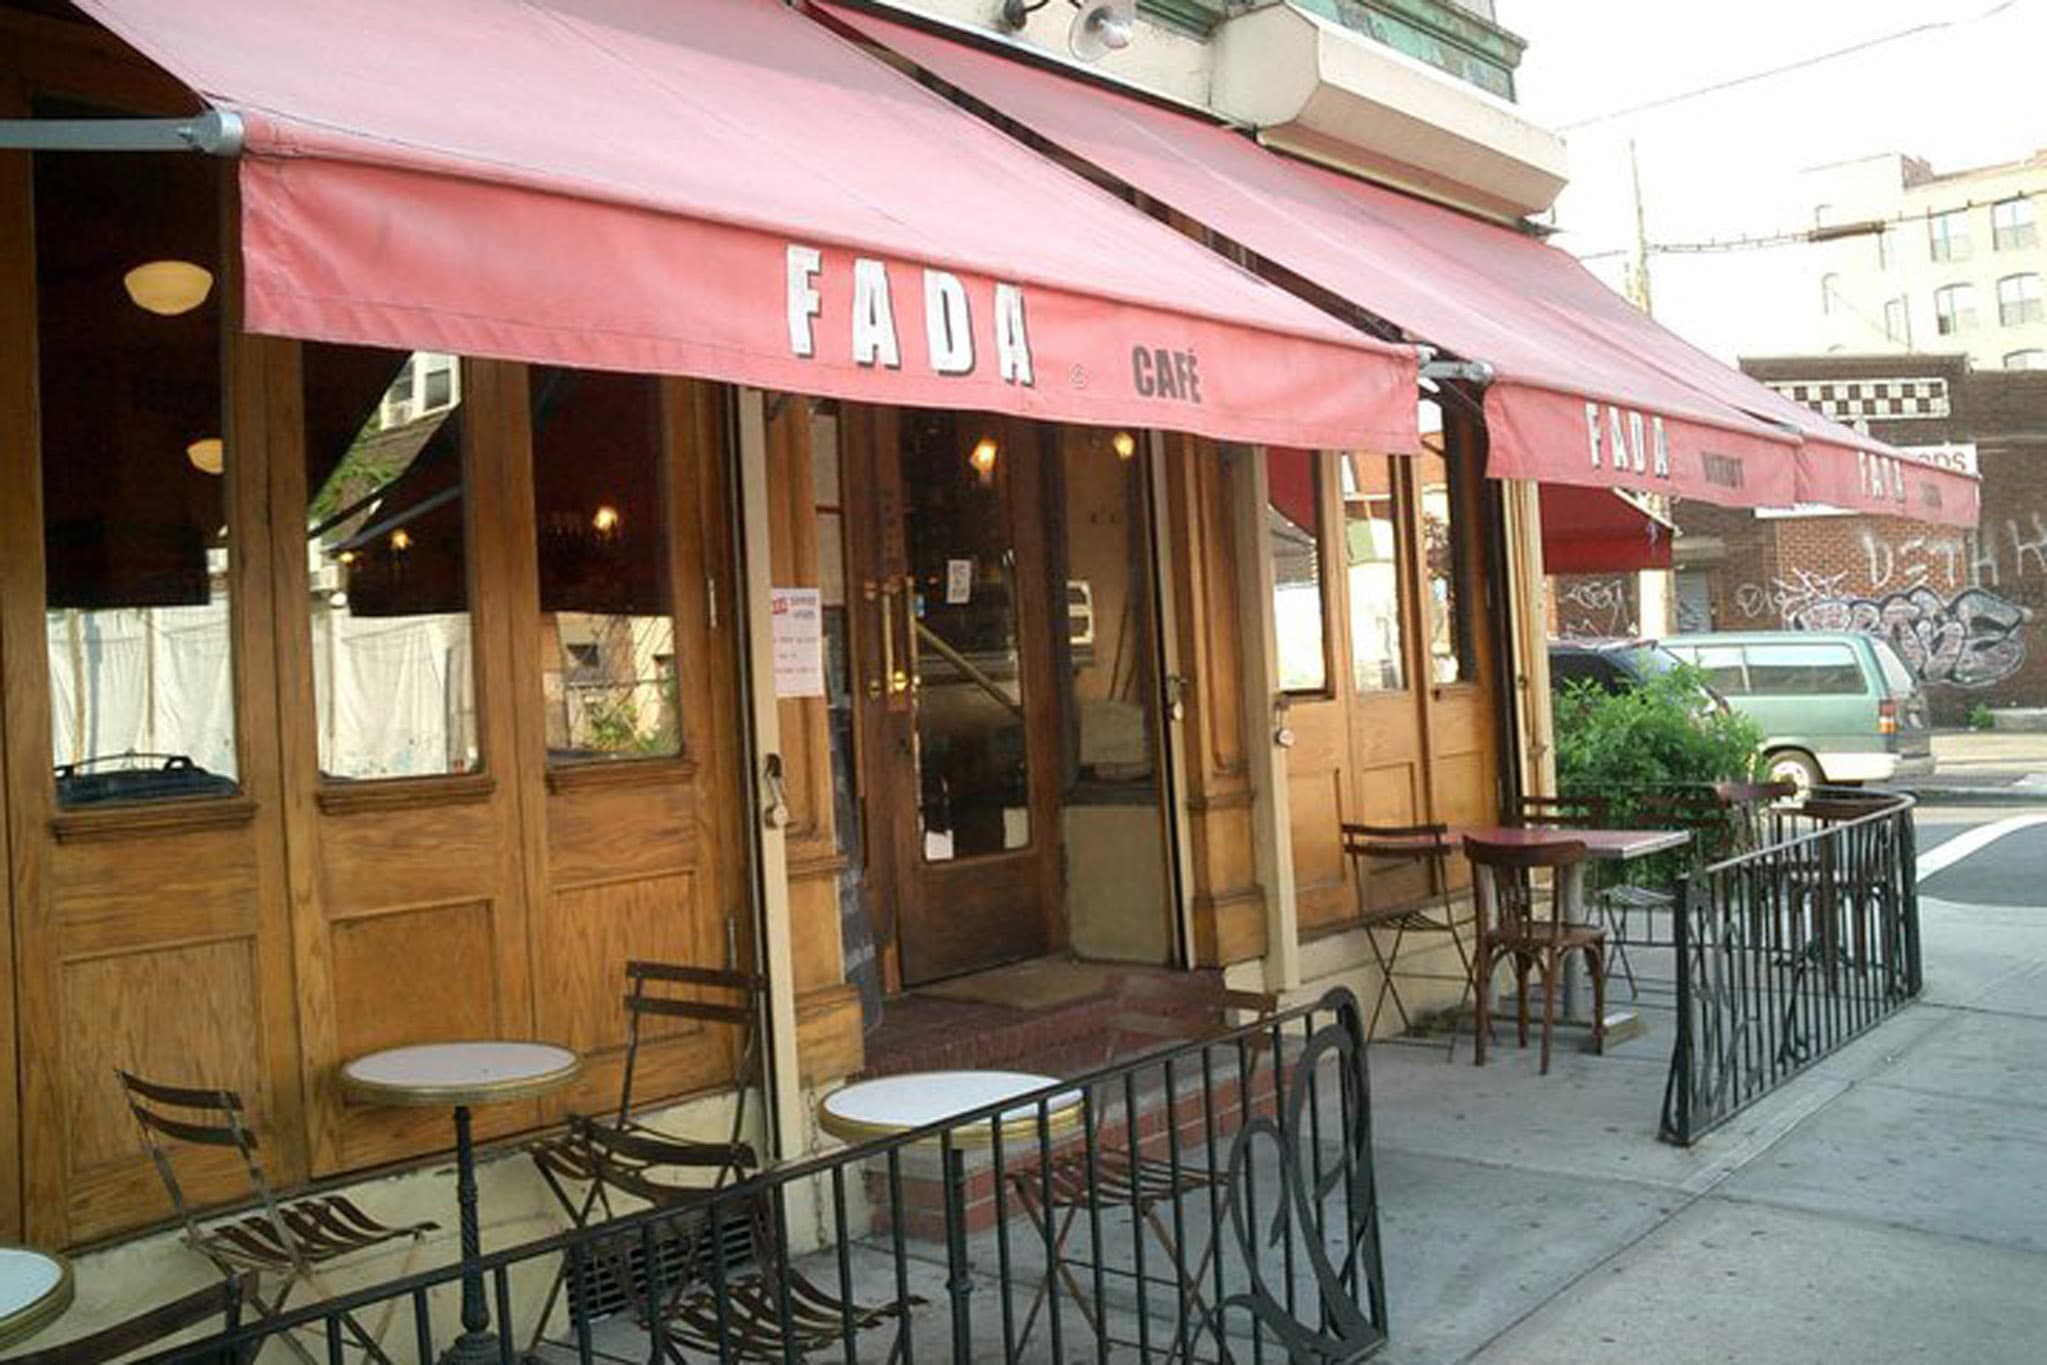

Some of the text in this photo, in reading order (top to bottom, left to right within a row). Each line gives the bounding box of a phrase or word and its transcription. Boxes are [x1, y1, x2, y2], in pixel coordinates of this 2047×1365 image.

[785, 244, 1202, 403] FADA CAFÉ
[1585, 402, 1670, 480] FADA
